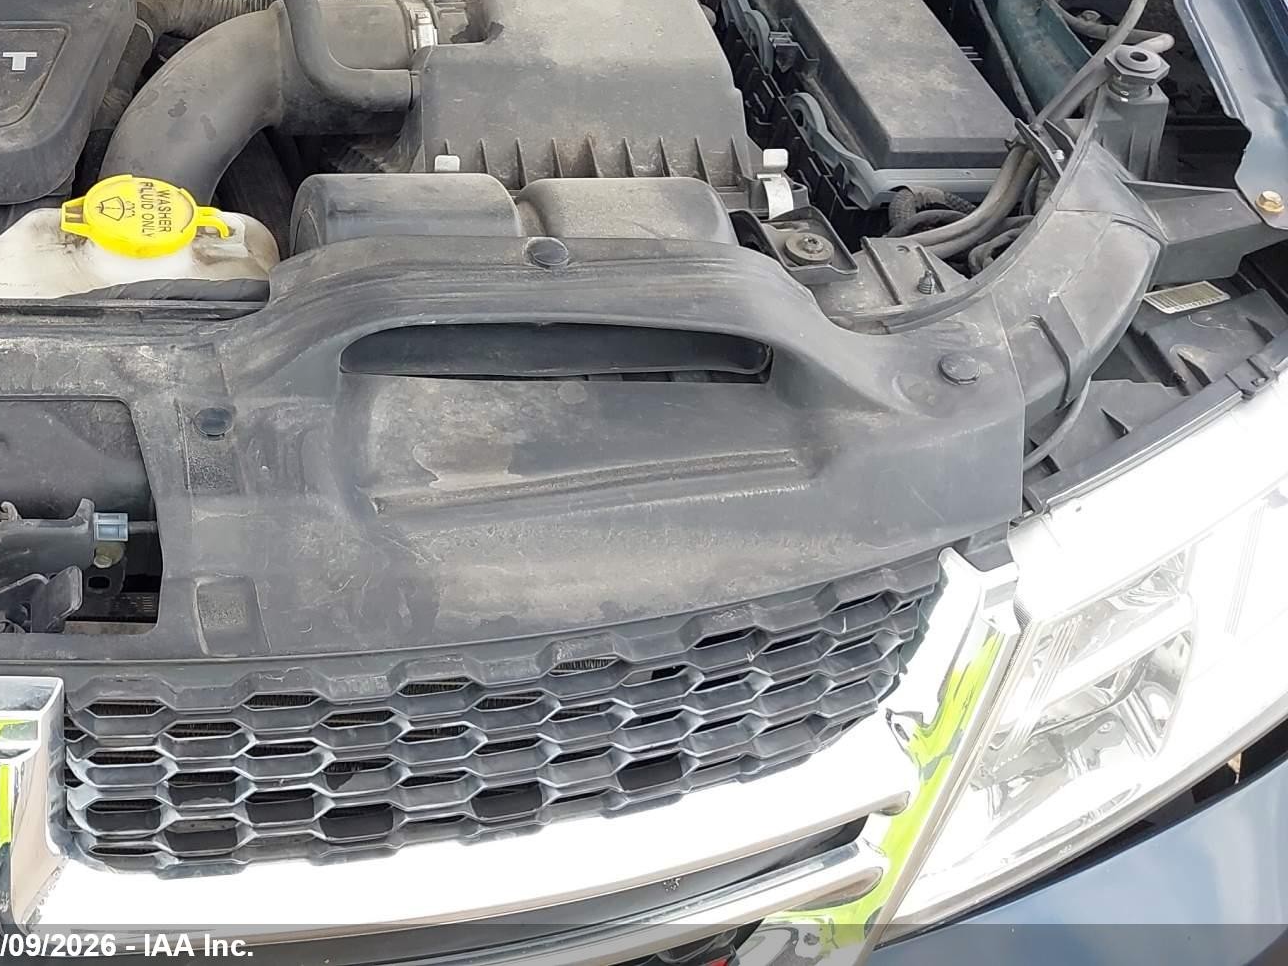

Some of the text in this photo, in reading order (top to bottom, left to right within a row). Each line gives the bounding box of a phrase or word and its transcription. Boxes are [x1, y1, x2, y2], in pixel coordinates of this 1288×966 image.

[139, 181, 155, 238] FLUID ONLY
[157, 189, 172, 233] WASHER
